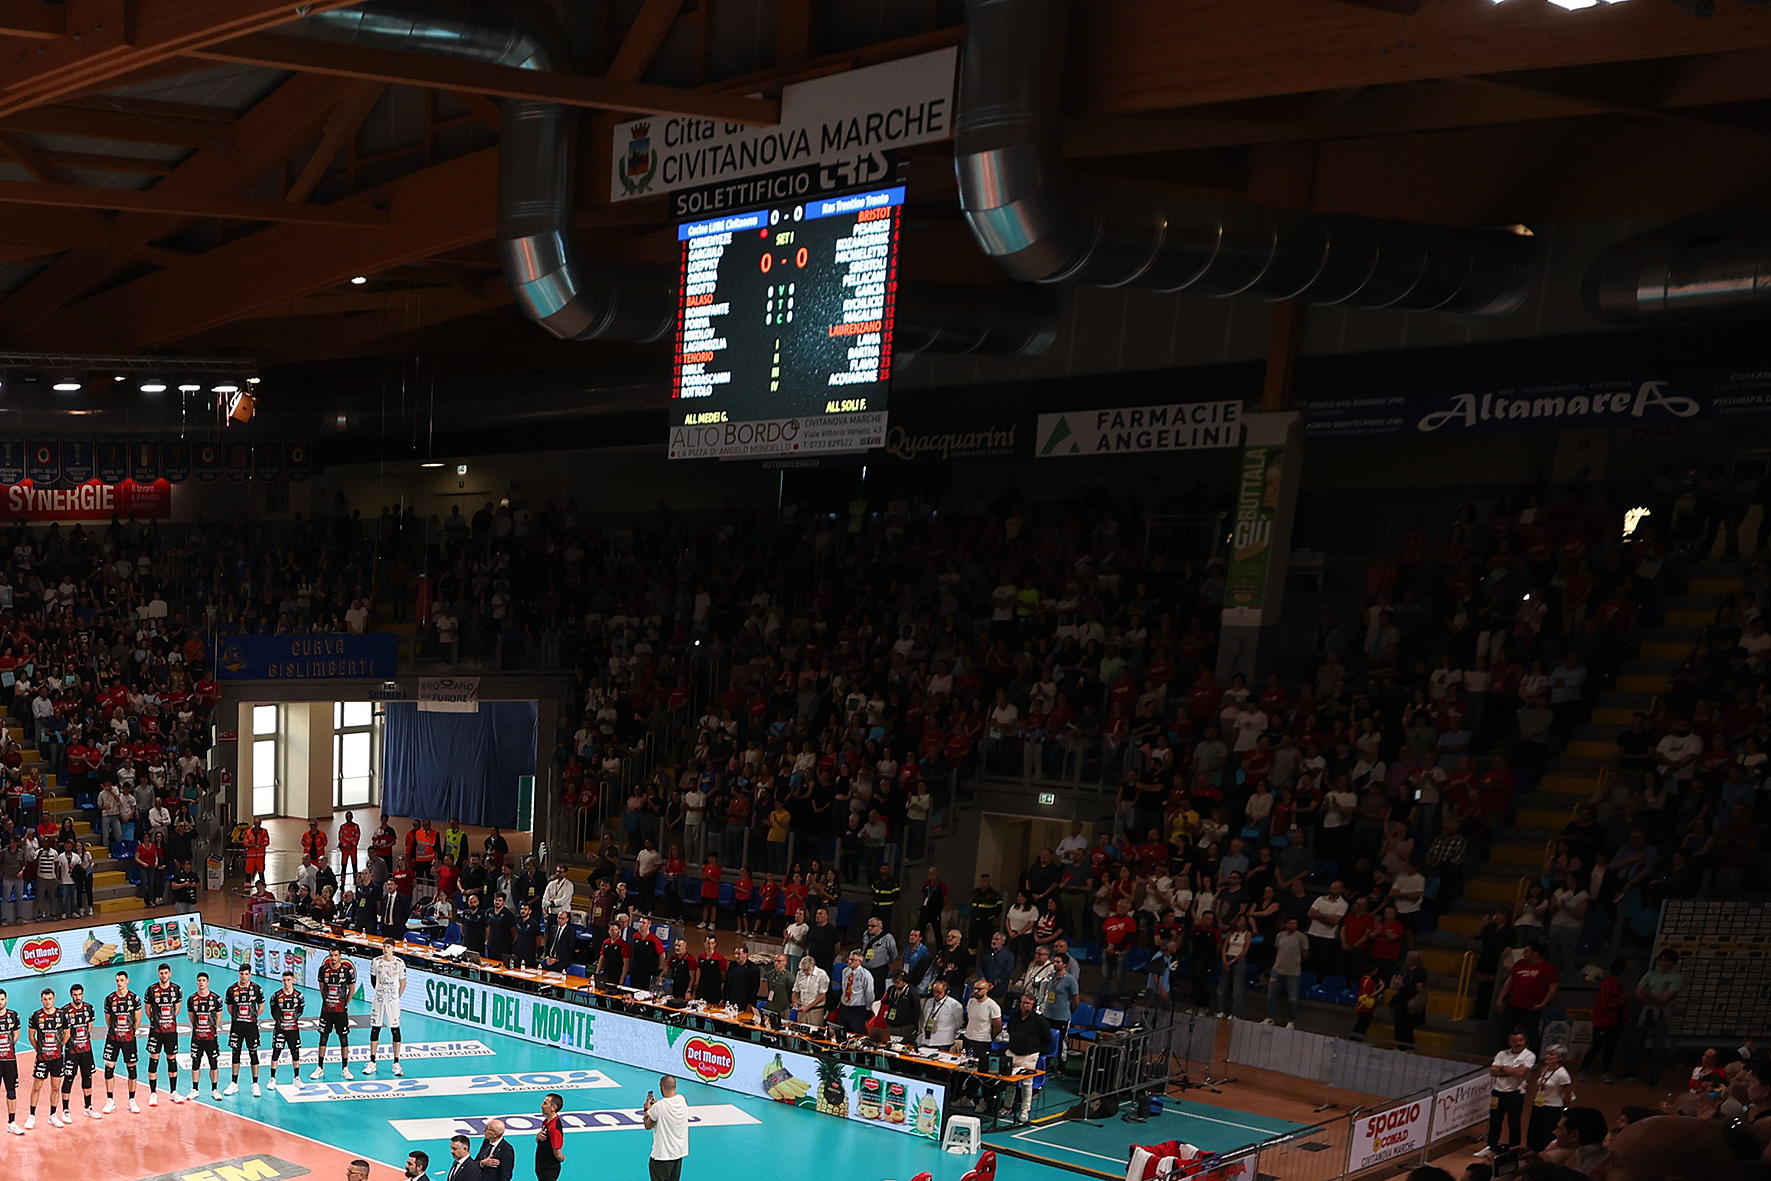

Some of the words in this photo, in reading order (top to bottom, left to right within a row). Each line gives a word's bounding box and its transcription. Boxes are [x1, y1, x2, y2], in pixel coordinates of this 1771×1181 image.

[663, 129, 810, 183] CIVITANOVA
[821, 99, 945, 154] MARCHE
[677, 171, 811, 216] SOLETTIFICIO
[836, 198, 865, 212] Trentino
[866, 193, 889, 207] Trento
[858, 206, 892, 223] BRISTOT
[688, 224, 708, 236] Cucine
[709, 220, 725, 233] LUBE
[725, 216, 758, 230] Civitanova
[853, 218, 890, 236] PESARESI
[776, 231, 791, 246] SET
[688, 245, 724, 261] GARGIULO
[760, 252, 773, 273] 0
[796, 247, 808, 268] 0
[834, 244, 888, 264] MICHIELETTO
[849, 257, 887, 274] SBERTOLI
[842, 269, 886, 287] PELLACANI
[855, 282, 885, 297] GARCIA
[686, 293, 714, 307] BALASO
[843, 307, 883, 324] MAGALINI
[828, 320, 882, 337] LAURENZANO
[857, 332, 881, 346] LAVIA
[683, 351, 714, 364] TENORIO
[847, 345, 880, 360] BARTHA
[881, 344, 892, 355] 22
[849, 357, 879, 372] FLAVIO
[880, 357, 891, 368] 23
[828, 369, 878, 386] ACQUARONE
[879, 369, 889, 380] 25
[680, 385, 713, 399] BOTTOLO
[825, 400, 840, 413] ALL
[841, 399, 859, 412] SOLI
[685, 413, 697, 425] ALL
[698, 411, 720, 424] MEDEI
[804, 419, 848, 428] CIVITANOVA
[850, 414, 882, 425] MARCHE
[1097, 403, 1238, 430] FARMACIE
[672, 426, 720, 449] ALTO
[725, 418, 800, 445] BORDO
[1097, 426, 1231, 452] ANGELINI
[886, 424, 1018, 462] Quacquarini
[8, 484, 115, 512] SYNERGIE
[292, 639, 346, 656] CURVA
[269, 660, 376, 678] GISLIMBERTI
[425, 978, 487, 1025] SCEGLI
[492, 993, 525, 1034] DEL
[531, 1002, 595, 1050] MONTE
[687, 1046, 703, 1061] Del
[703, 1050, 731, 1068] Monte
[1366, 1103, 1421, 1138] spazio
[1381, 1129, 1409, 1148] CONAD
